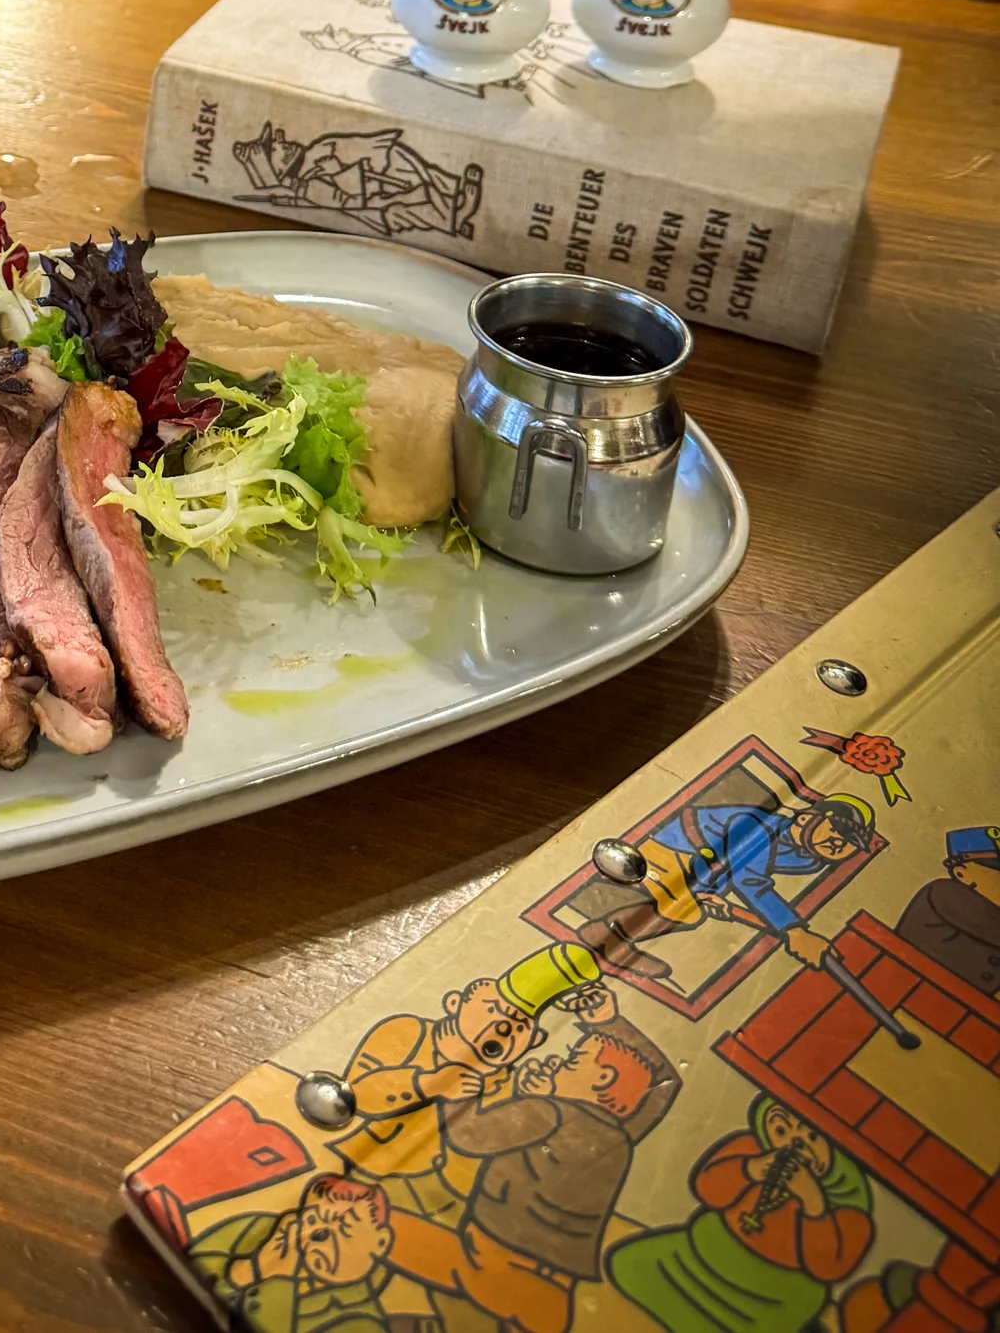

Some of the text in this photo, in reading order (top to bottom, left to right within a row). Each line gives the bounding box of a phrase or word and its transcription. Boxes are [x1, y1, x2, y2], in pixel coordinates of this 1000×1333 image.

[527, 202, 554, 241] DIE
[565, 168, 606, 275] BENTEUER
[608, 222, 637, 263] DES
[645, 210, 685, 293] BRAVEN
[684, 208, 732, 313] SOLDATEN
[726, 222, 773, 321] SCHWEJK
